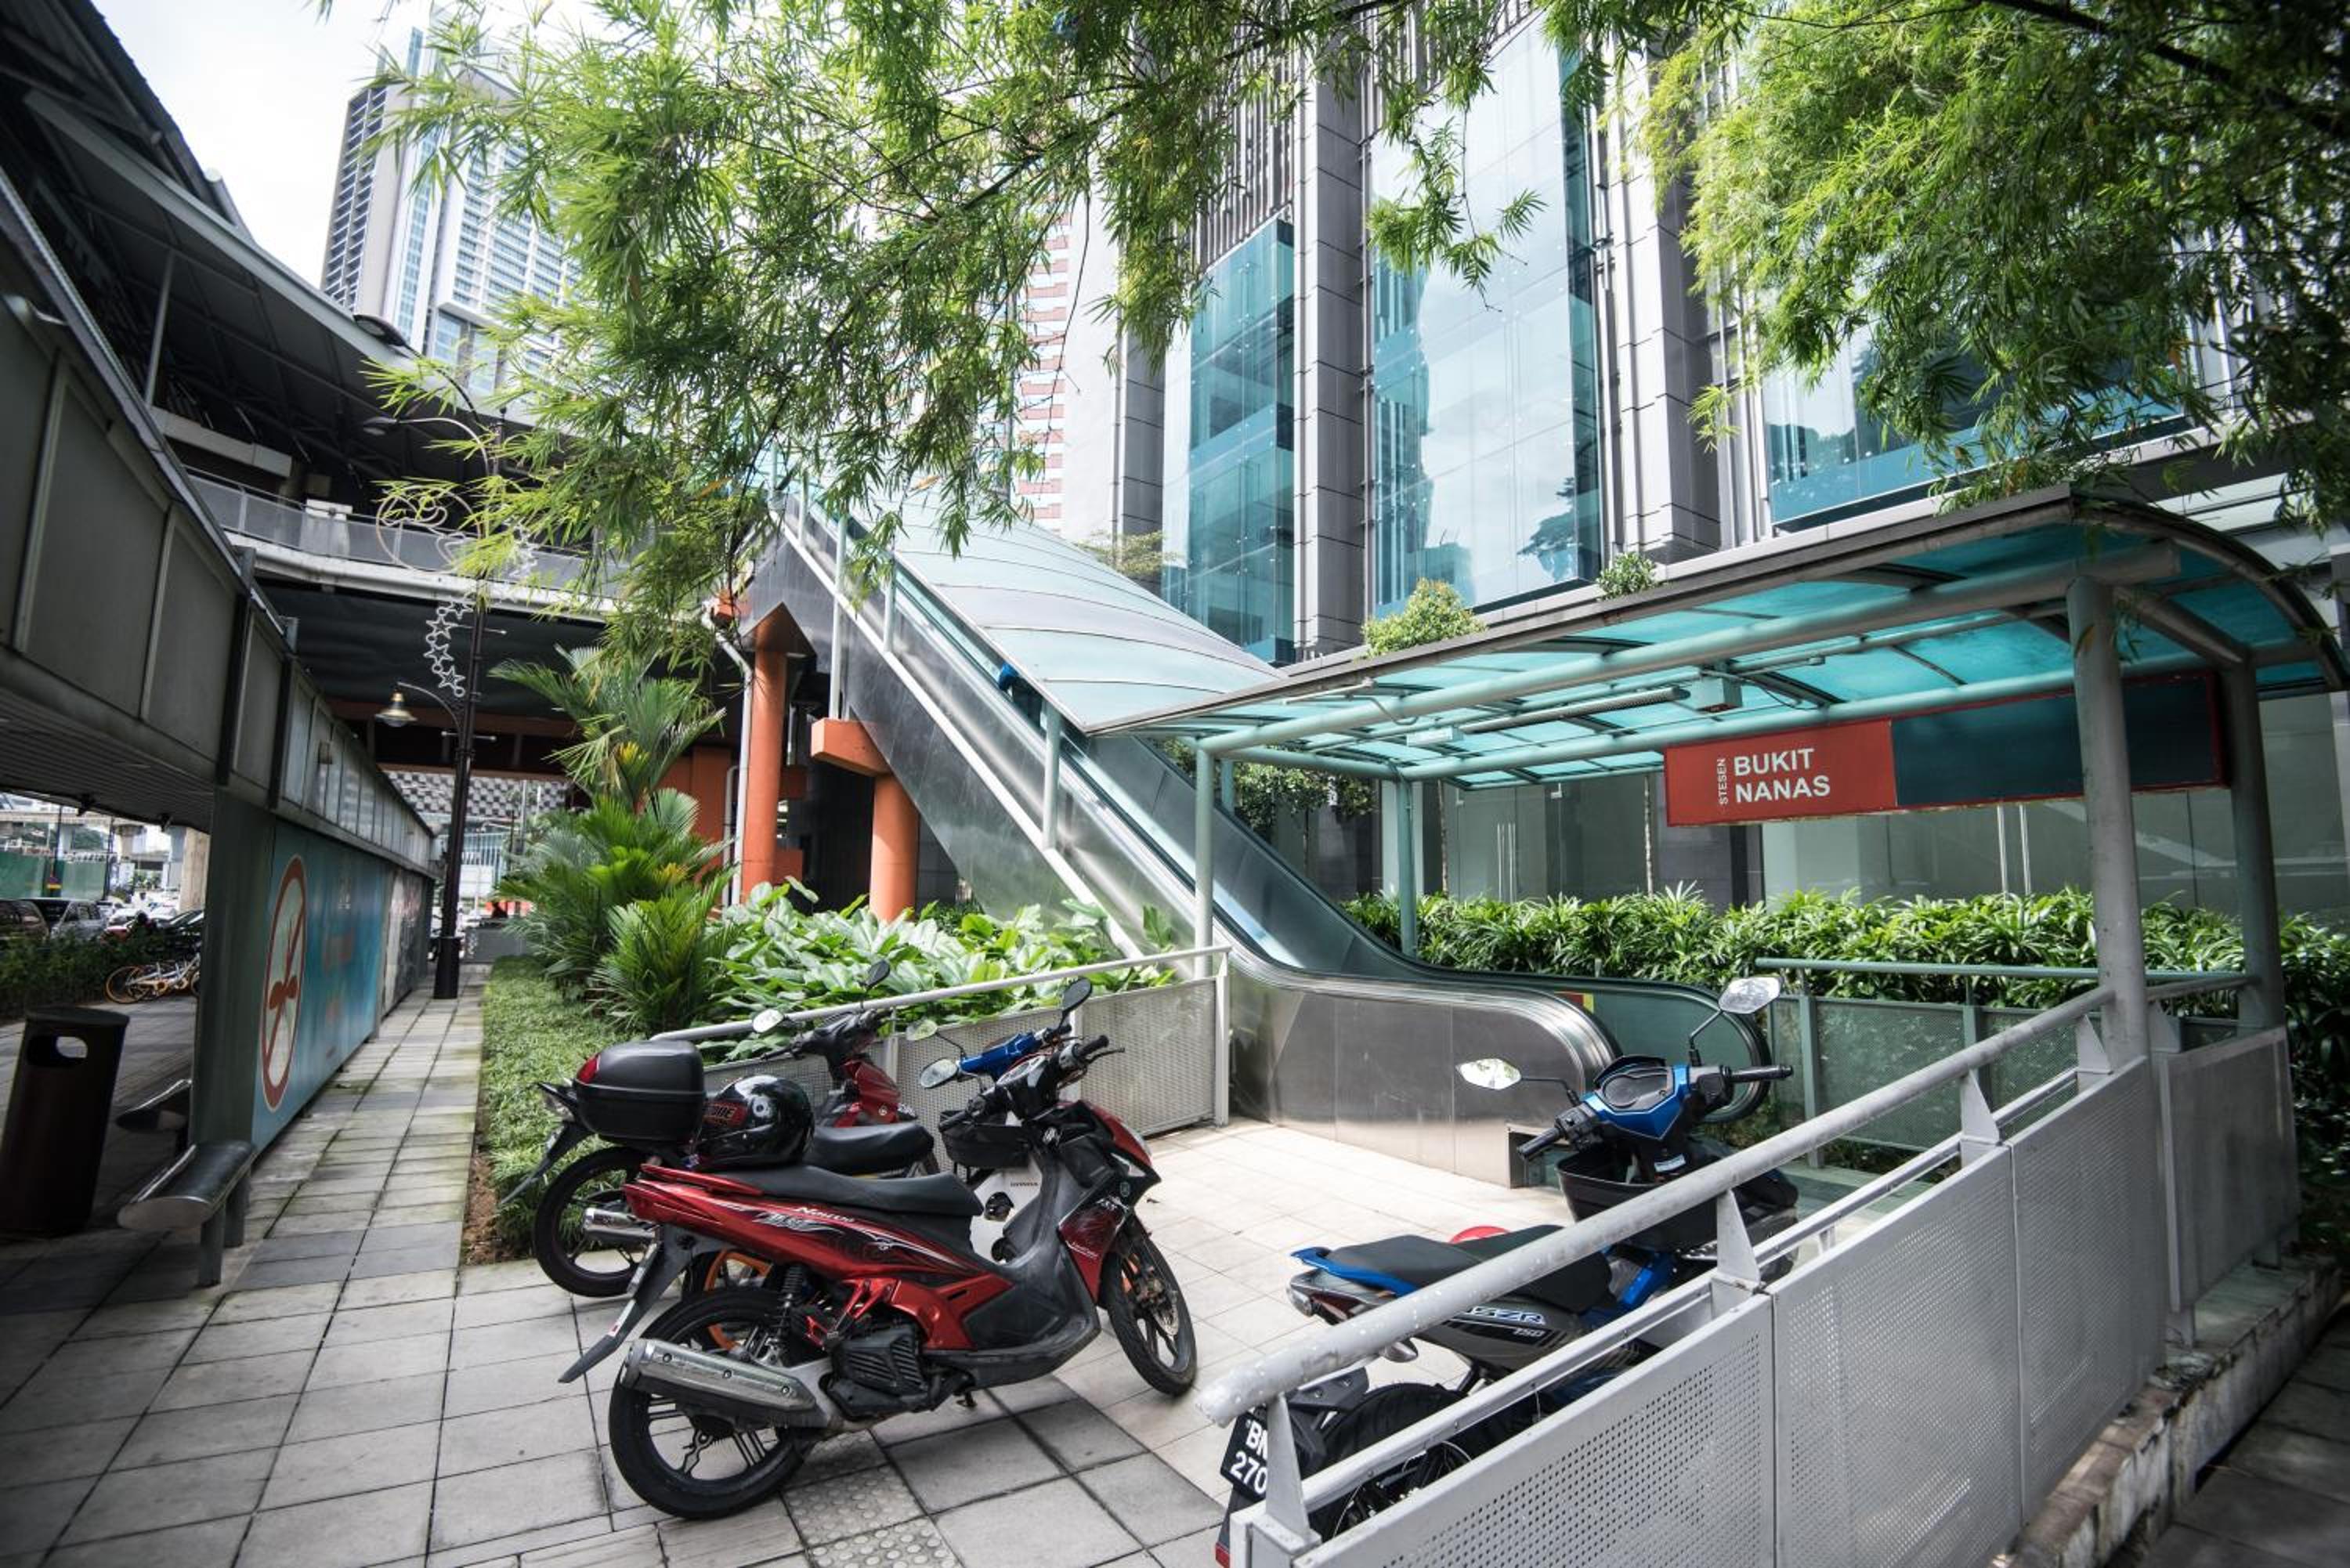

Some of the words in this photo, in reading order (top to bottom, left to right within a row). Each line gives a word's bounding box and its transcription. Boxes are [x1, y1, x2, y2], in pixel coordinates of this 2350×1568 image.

[1734, 748, 1815, 777] BUKIT
[1717, 757, 1728, 805] STESEN
[1735, 775, 1831, 804] NANAS
